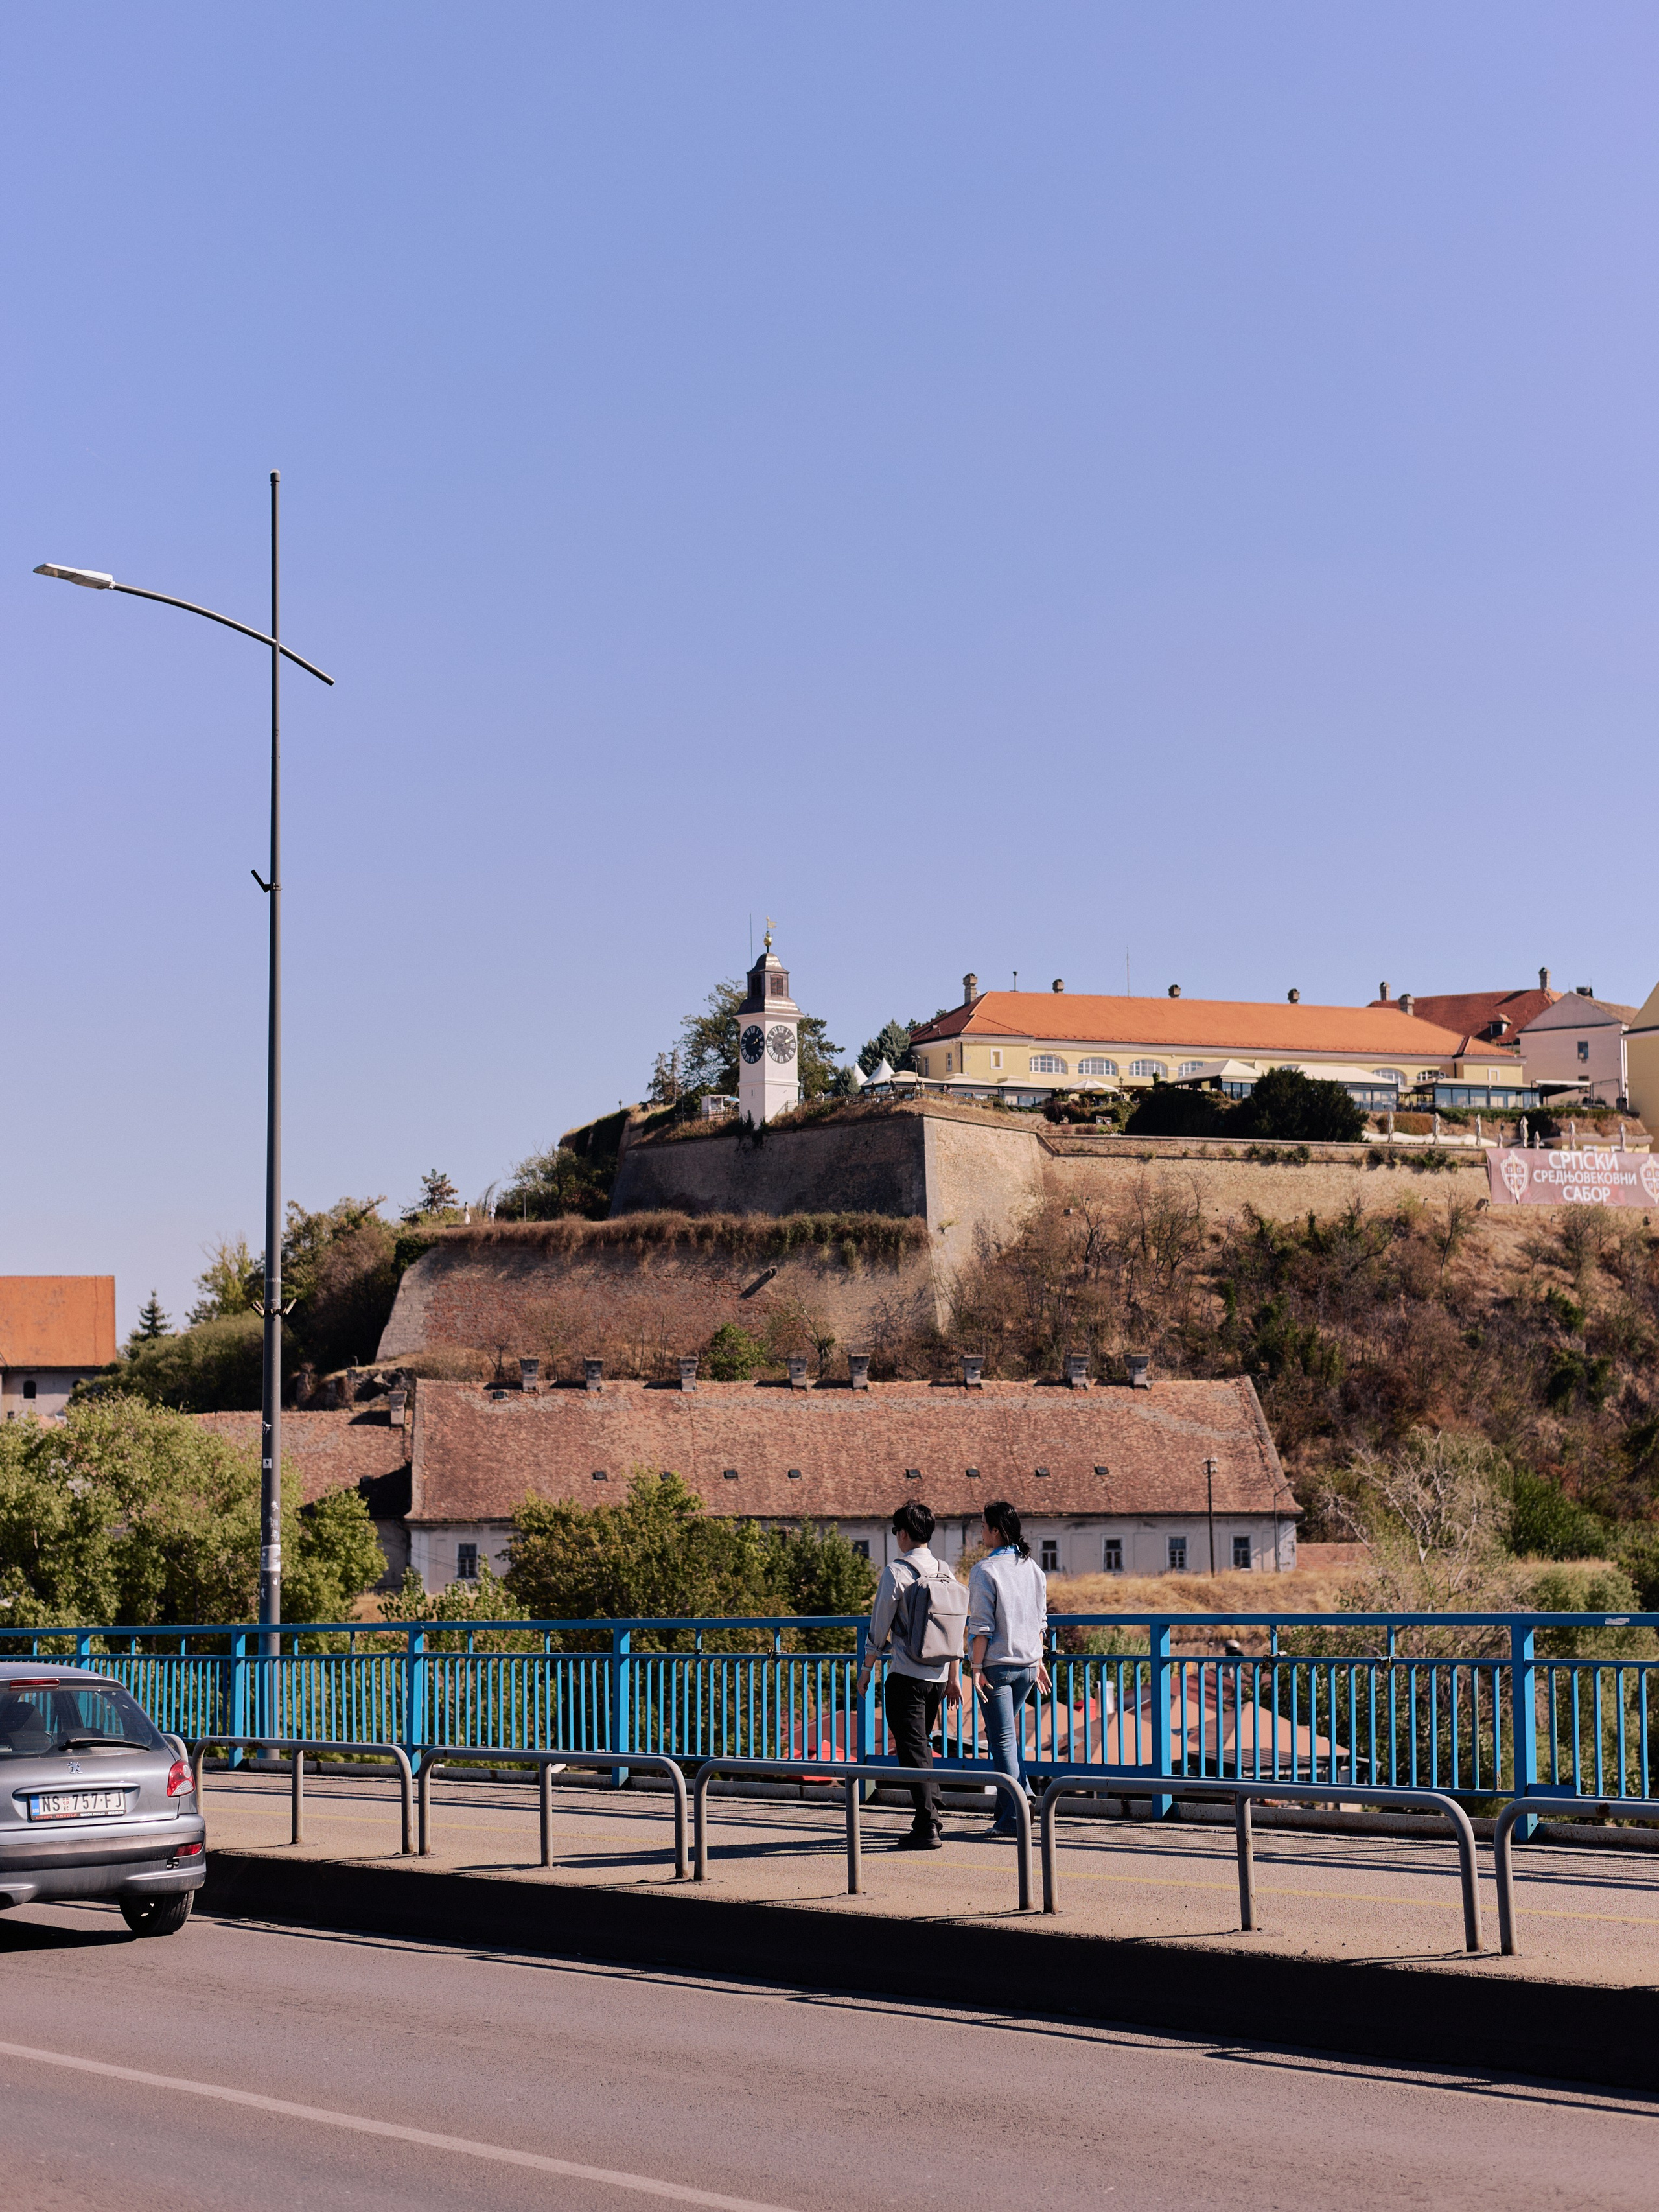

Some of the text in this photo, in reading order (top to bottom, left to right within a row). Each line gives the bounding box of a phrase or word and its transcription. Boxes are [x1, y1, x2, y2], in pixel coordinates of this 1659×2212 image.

[1549, 1151, 1619, 1170] СРПСКИ
[1533, 1170, 1637, 1185] СРЕДЊОВЕКОВНИ
[1562, 1185, 1610, 1202] САБОР
[42, 1795, 60, 1812] NS
